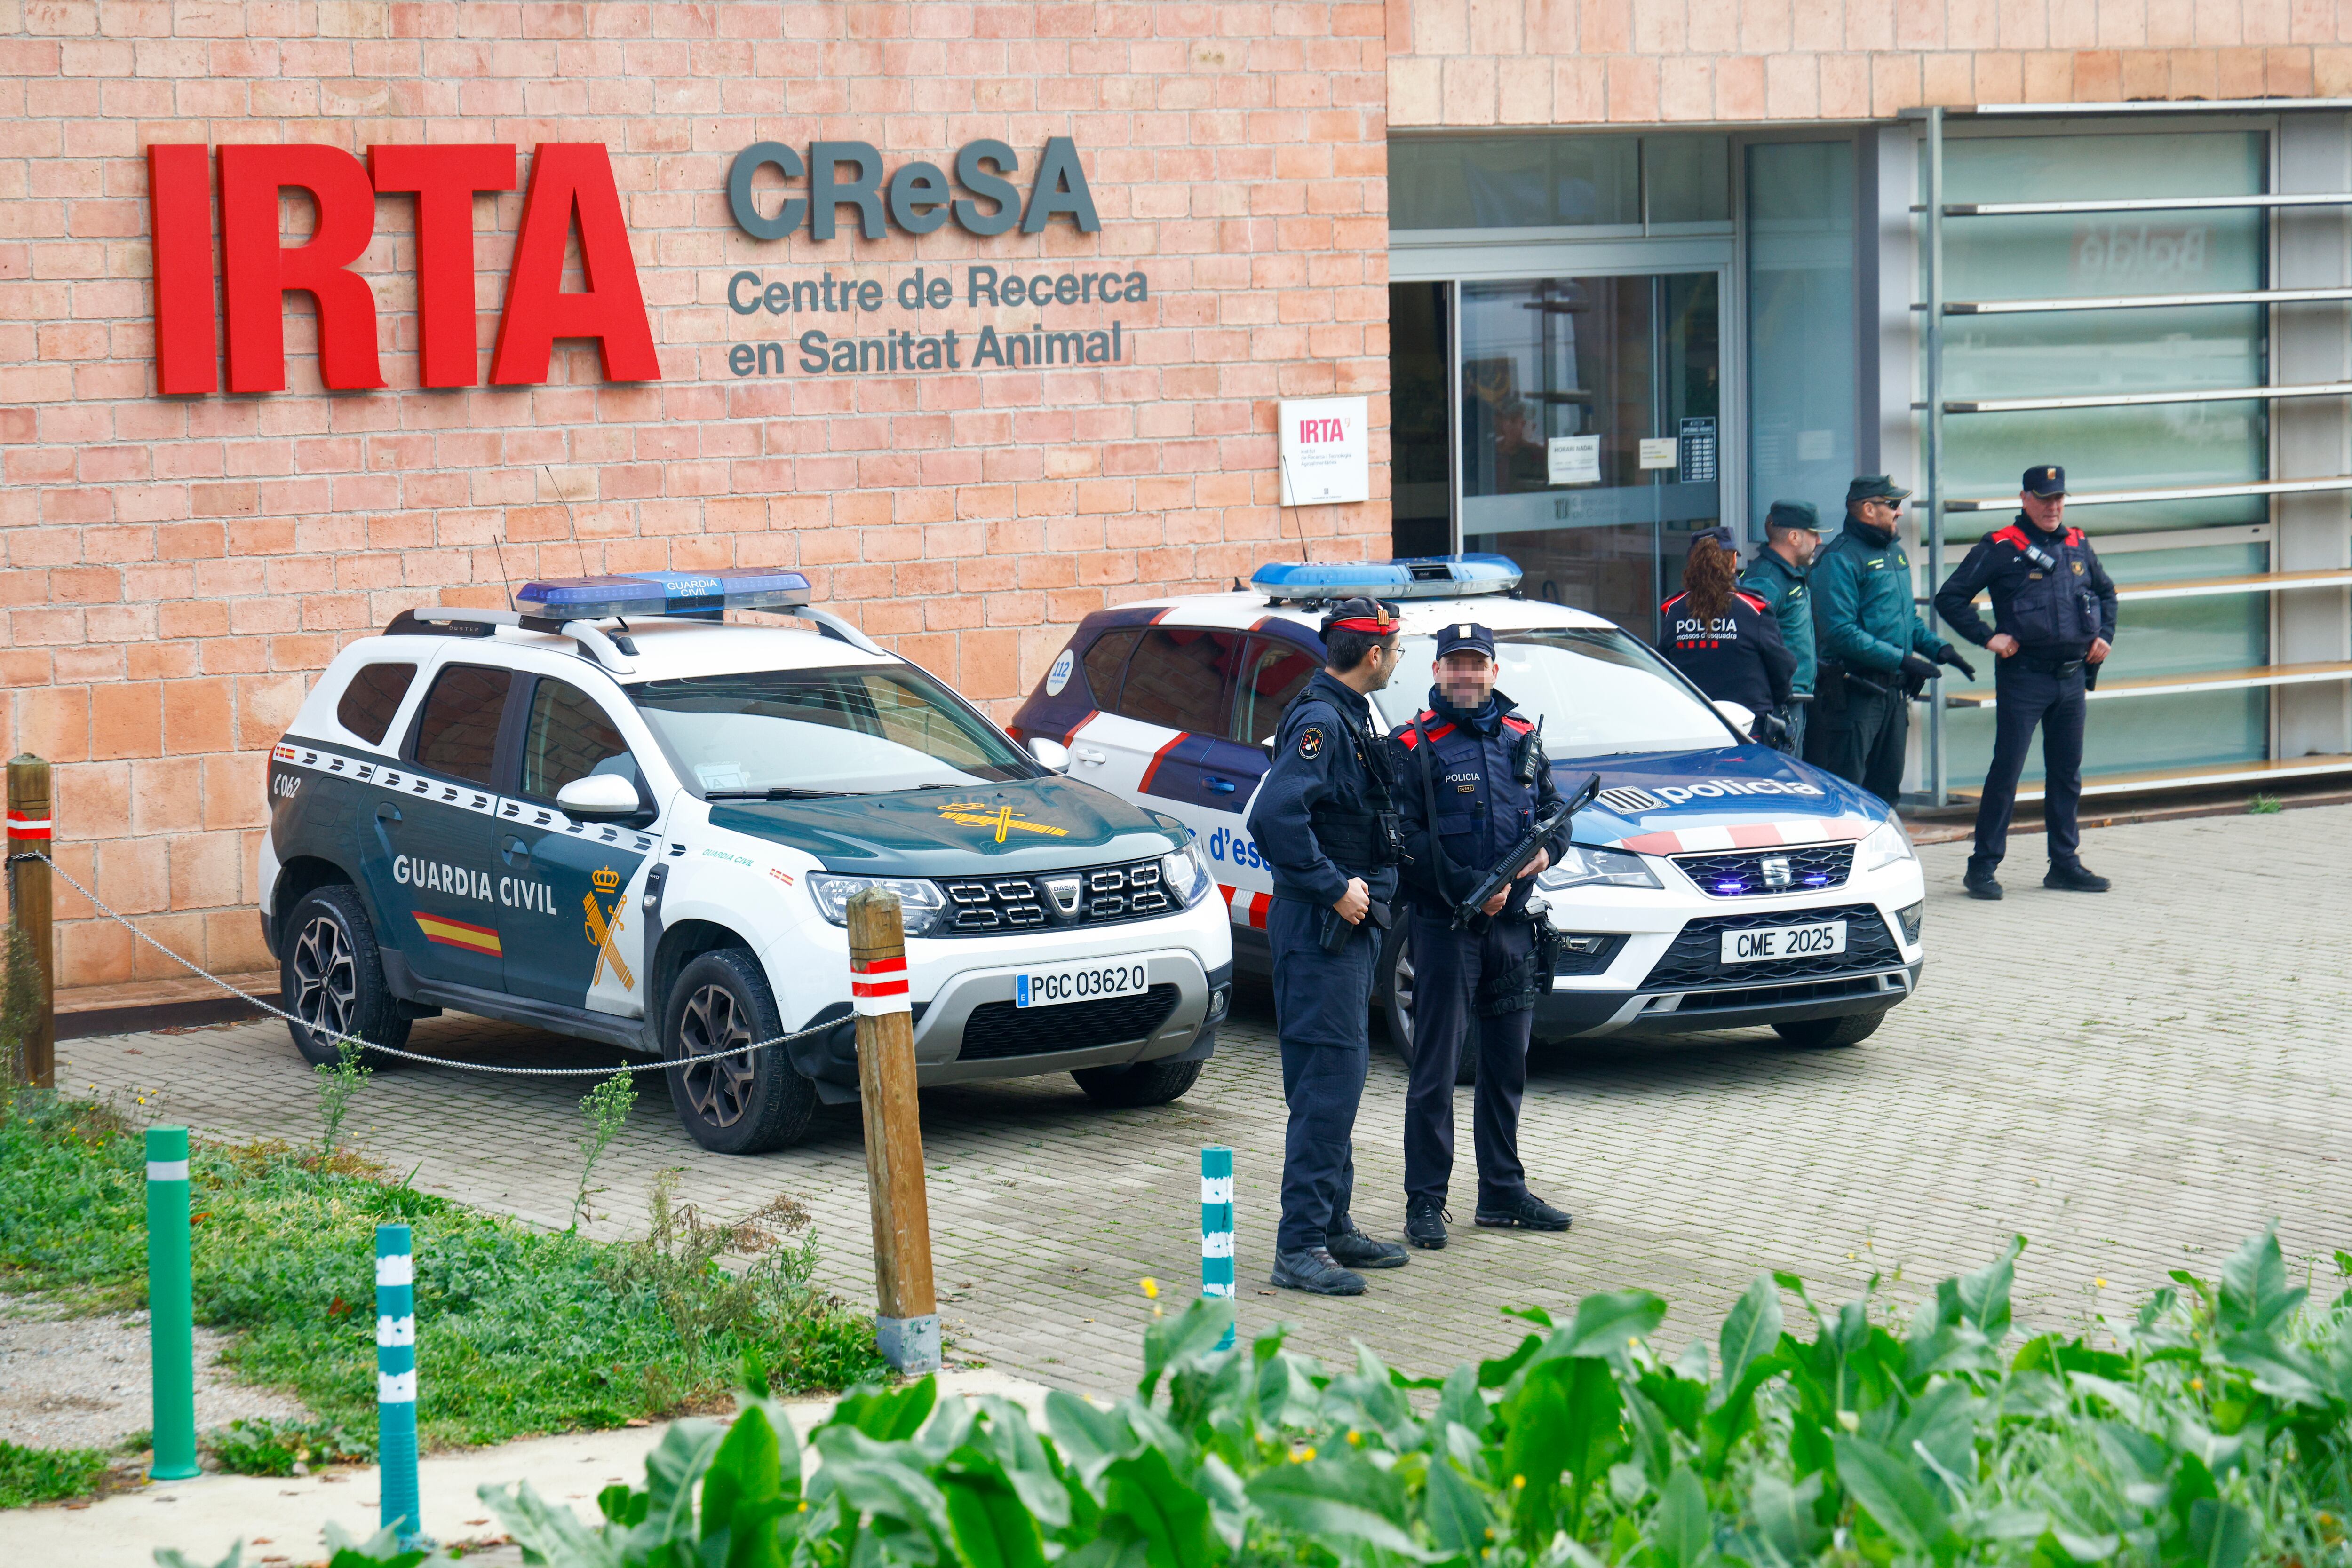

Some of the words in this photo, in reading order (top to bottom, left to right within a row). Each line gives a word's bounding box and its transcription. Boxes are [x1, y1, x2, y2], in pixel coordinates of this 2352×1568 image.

[728, 136, 1102, 241] CReSA
[148, 143, 662, 394] IRTA
[728, 271, 884, 315] Centre
[898, 267, 953, 309] de
[968, 266, 1148, 308] Recerca
[729, 342, 784, 377] en
[799, 328, 961, 374] Sanitat
[972, 320, 1121, 367] Animal
[1300, 418, 1344, 443] IRTA
[667, 579, 717, 590] GUARDIA
[681, 588, 709, 596] CIVIL
[1676, 618, 1737, 633] POLCIA
[1052, 662, 1070, 677] 112
[1446, 773, 1480, 783] POLICIA
[1652, 778, 1826, 805] policia
[702, 849, 733, 861] GUARDIA
[734, 856, 754, 866] CIVIL
[393, 855, 493, 902] GUARDIA
[499, 877, 556, 915] CIVIL
[1738, 932, 1776, 957] CME
[1786, 927, 1834, 954] 2025
[1032, 974, 1072, 1002] PGC
